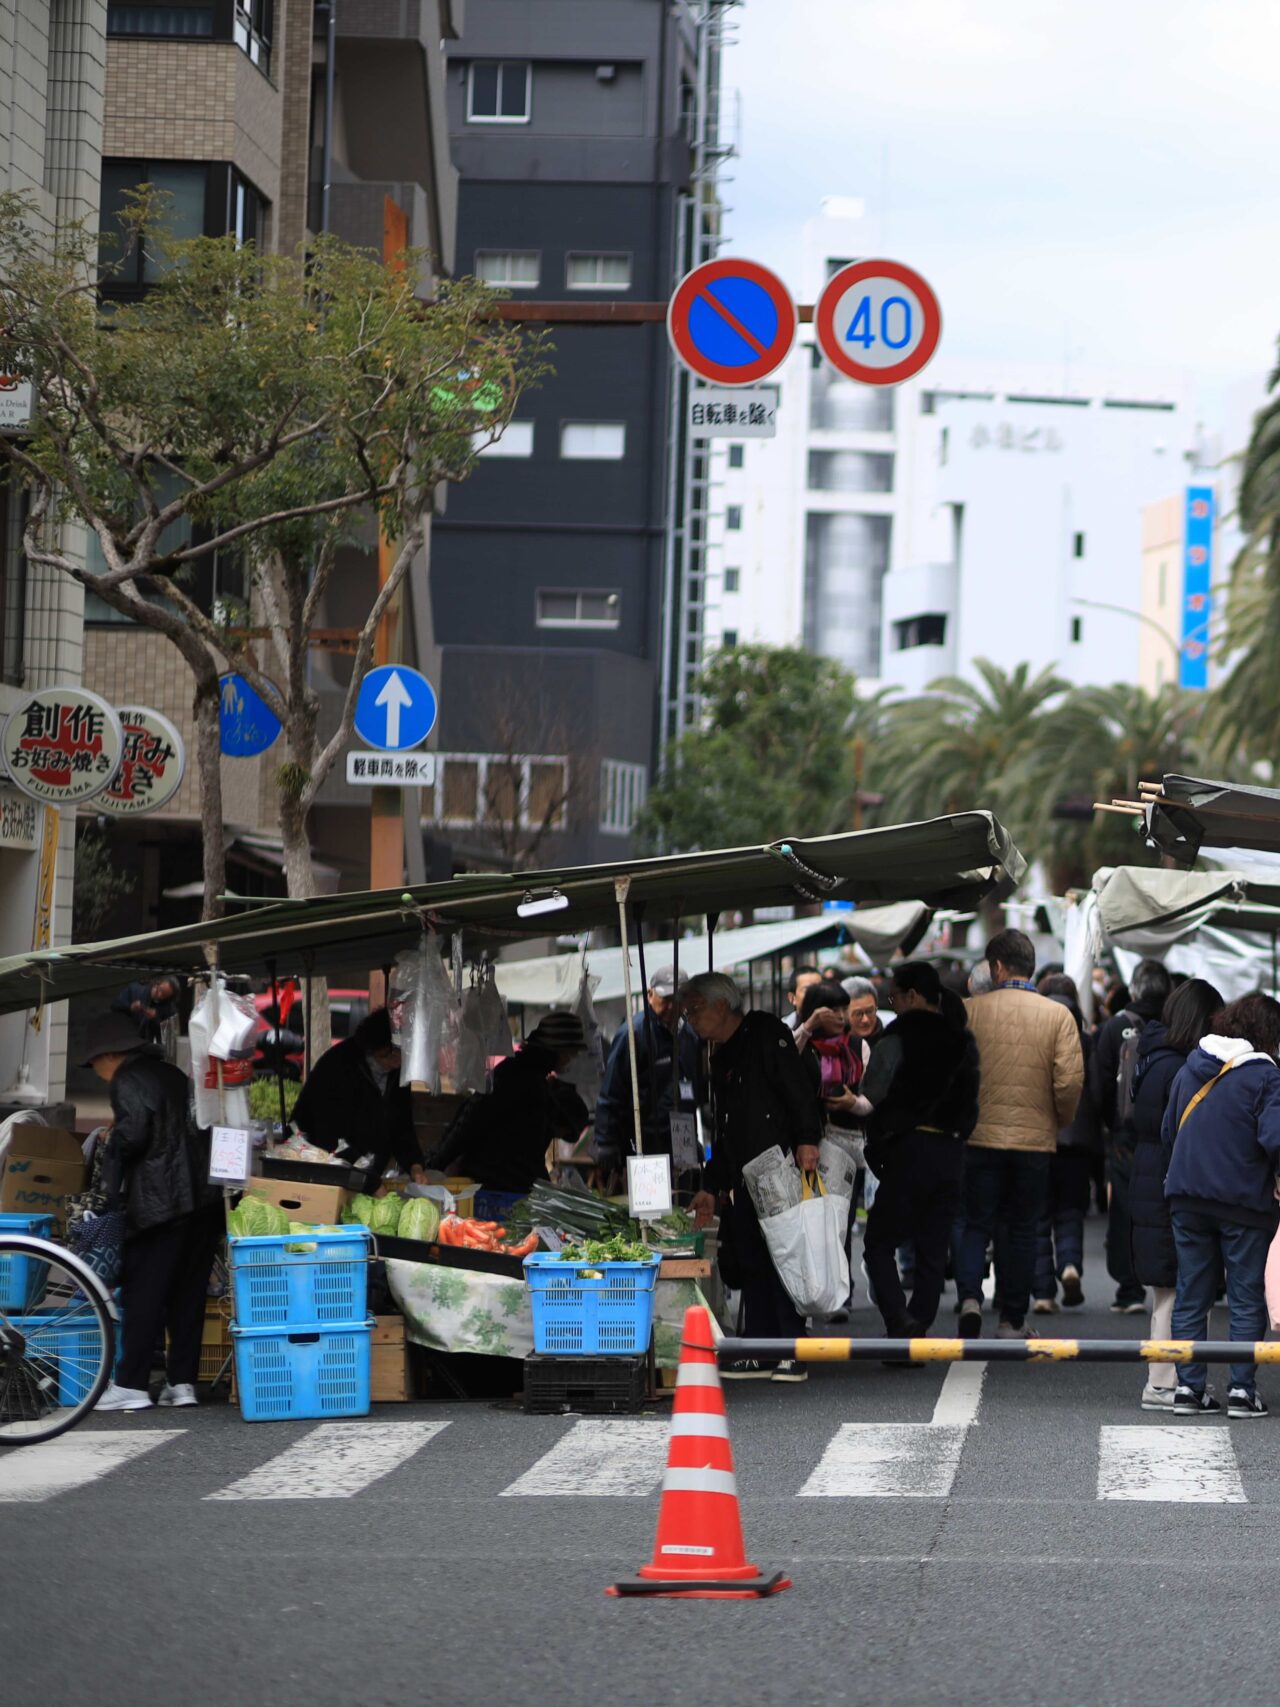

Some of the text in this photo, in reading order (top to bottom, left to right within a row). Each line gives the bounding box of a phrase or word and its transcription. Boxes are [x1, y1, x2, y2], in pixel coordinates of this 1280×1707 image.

[846, 295, 912, 350] 40
[692, 402, 775, 425] 自転車を除く
[21, 700, 105, 742] 創作
[11, 747, 110, 773] お好み焼き
[123, 732, 175, 764] 好み
[353, 758, 429, 779] 軽車両を除く
[26, 780, 93, 798] FUJIYAMA
[101, 796, 155, 811] UJIYAMA
